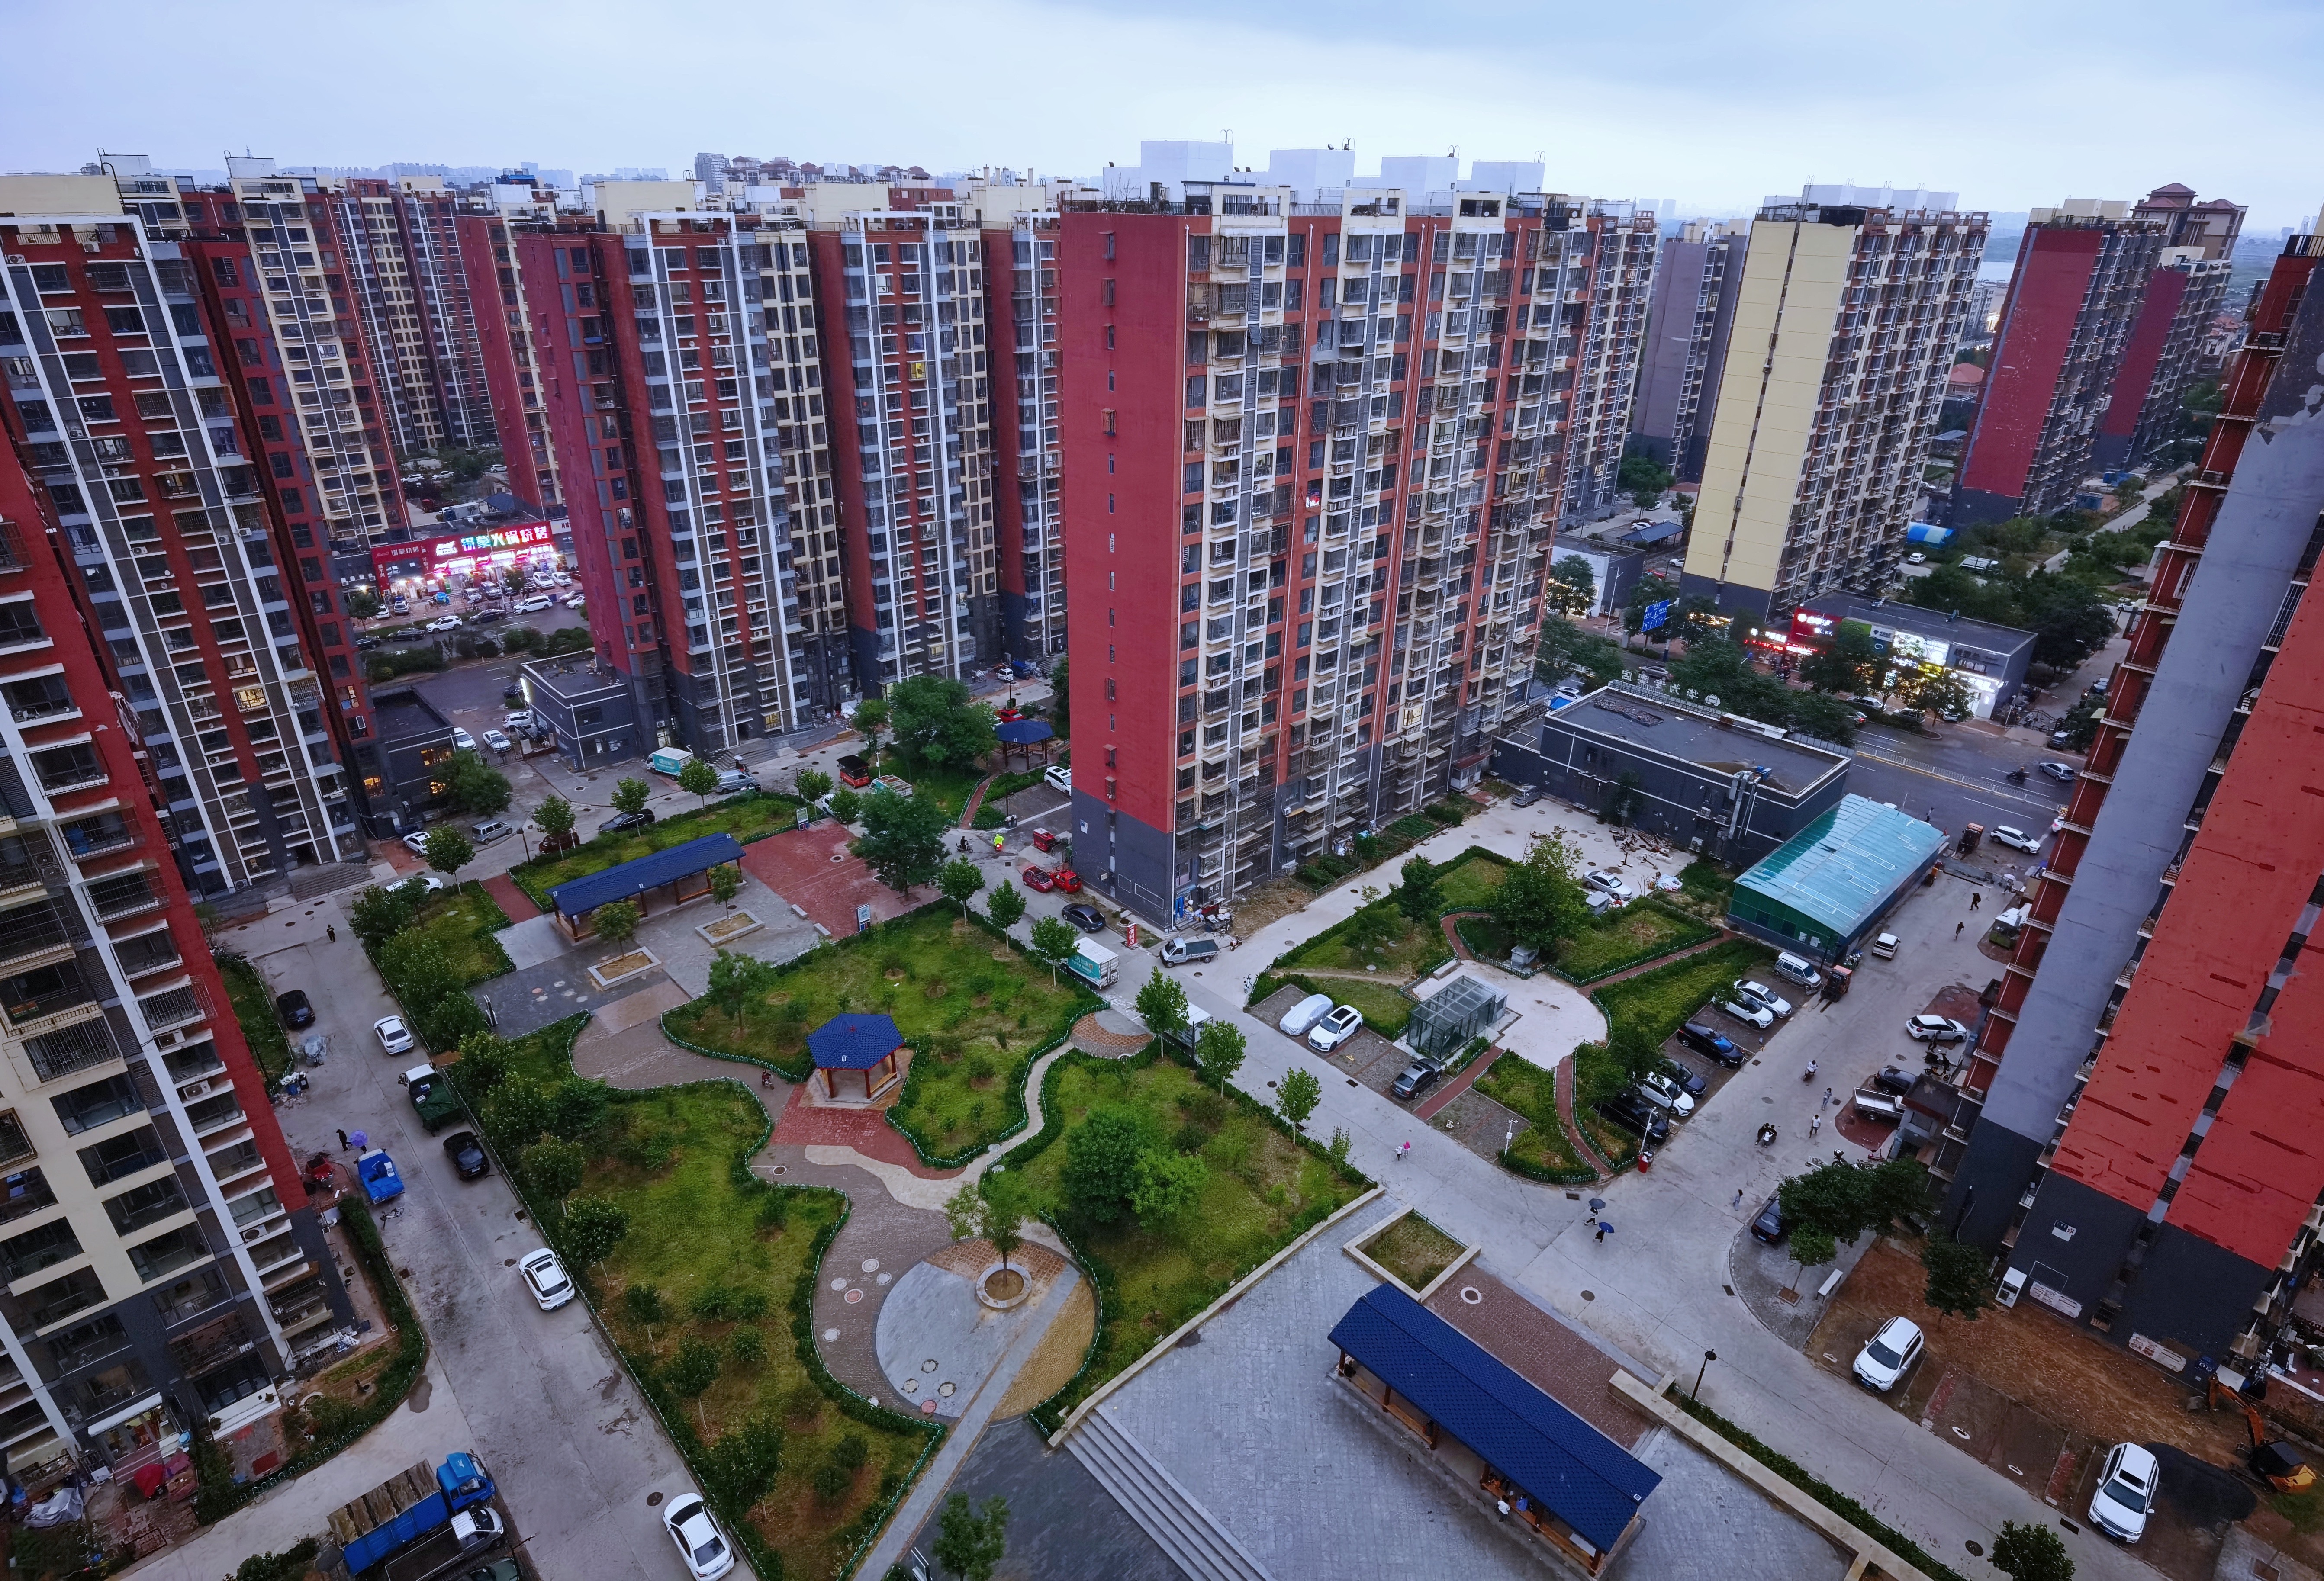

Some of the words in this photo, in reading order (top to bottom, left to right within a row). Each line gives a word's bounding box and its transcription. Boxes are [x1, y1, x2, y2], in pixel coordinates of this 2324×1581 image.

[461, 526, 548, 551] 锡蒙火锅烧烤
